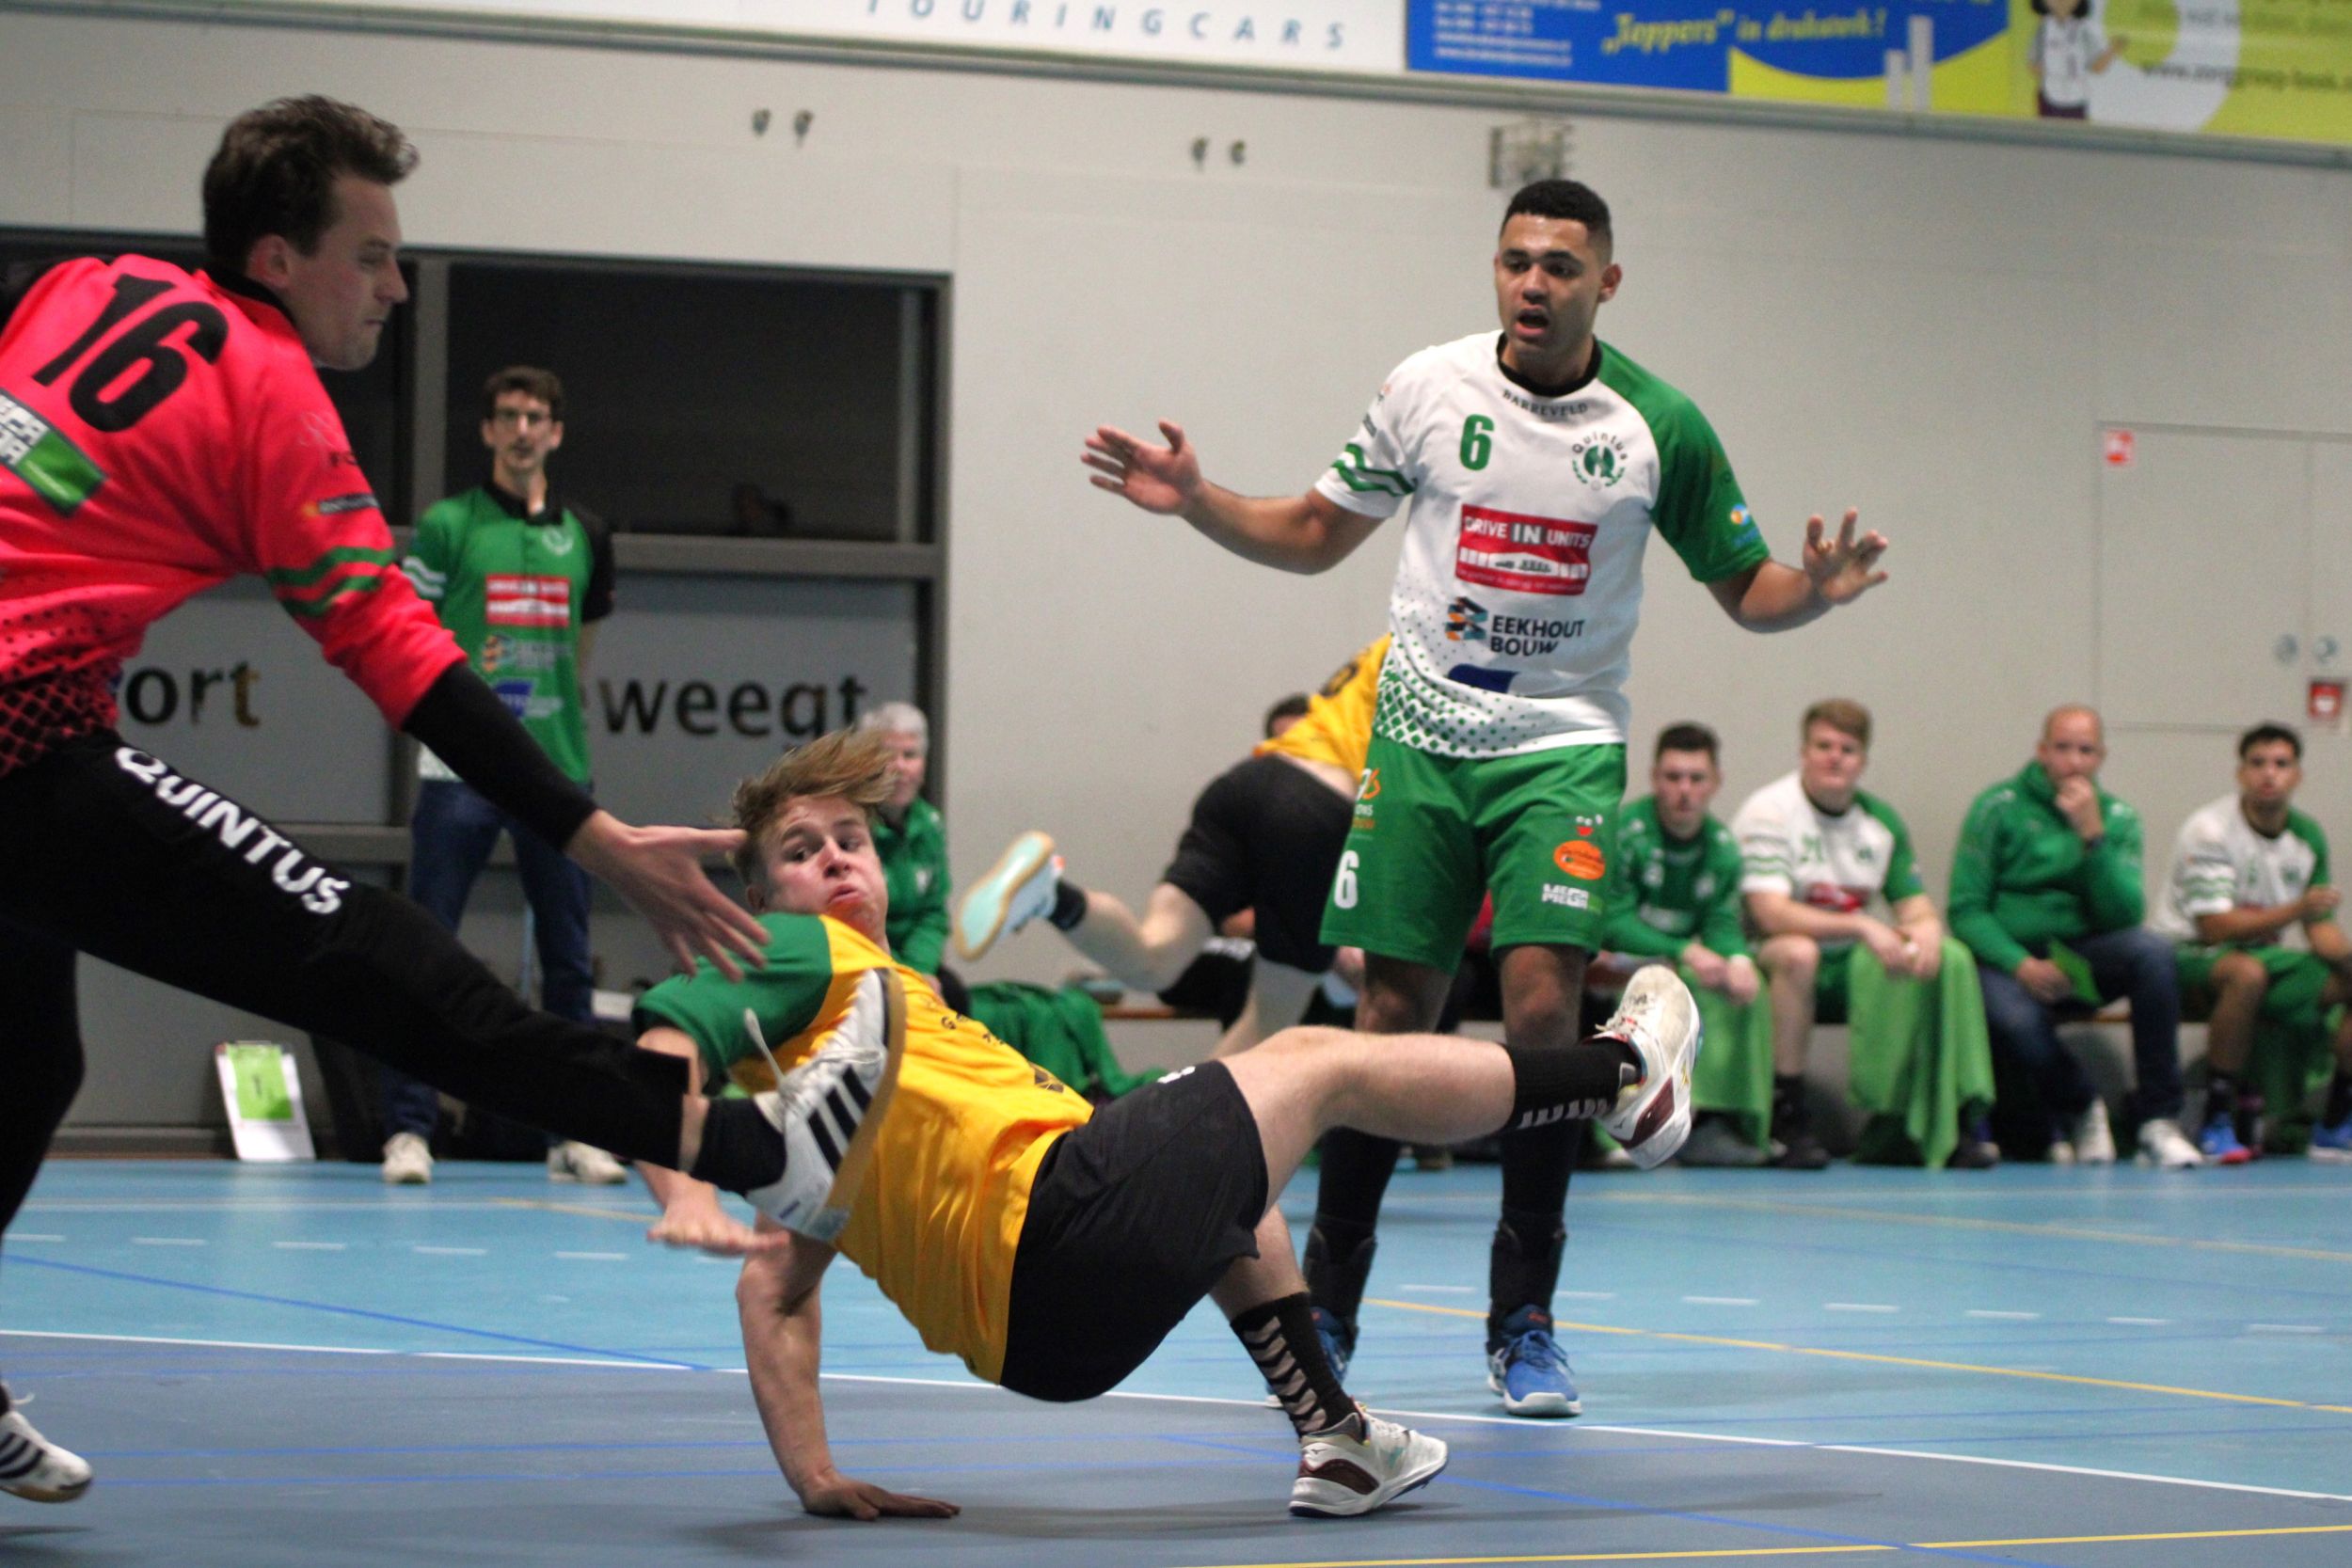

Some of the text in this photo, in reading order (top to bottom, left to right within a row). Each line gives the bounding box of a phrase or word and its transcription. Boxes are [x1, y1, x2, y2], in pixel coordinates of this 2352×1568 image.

[31, 274, 229, 433] 16
[1459, 414, 1494, 470] 6
[1463, 515, 1592, 549] DRIVE IN UNITS
[1489, 635, 1559, 657] BOUW
[1491, 614, 1585, 639] EEKHOUT
[115, 747, 352, 914] QUINTUS
[1333, 849, 1359, 910] 6
